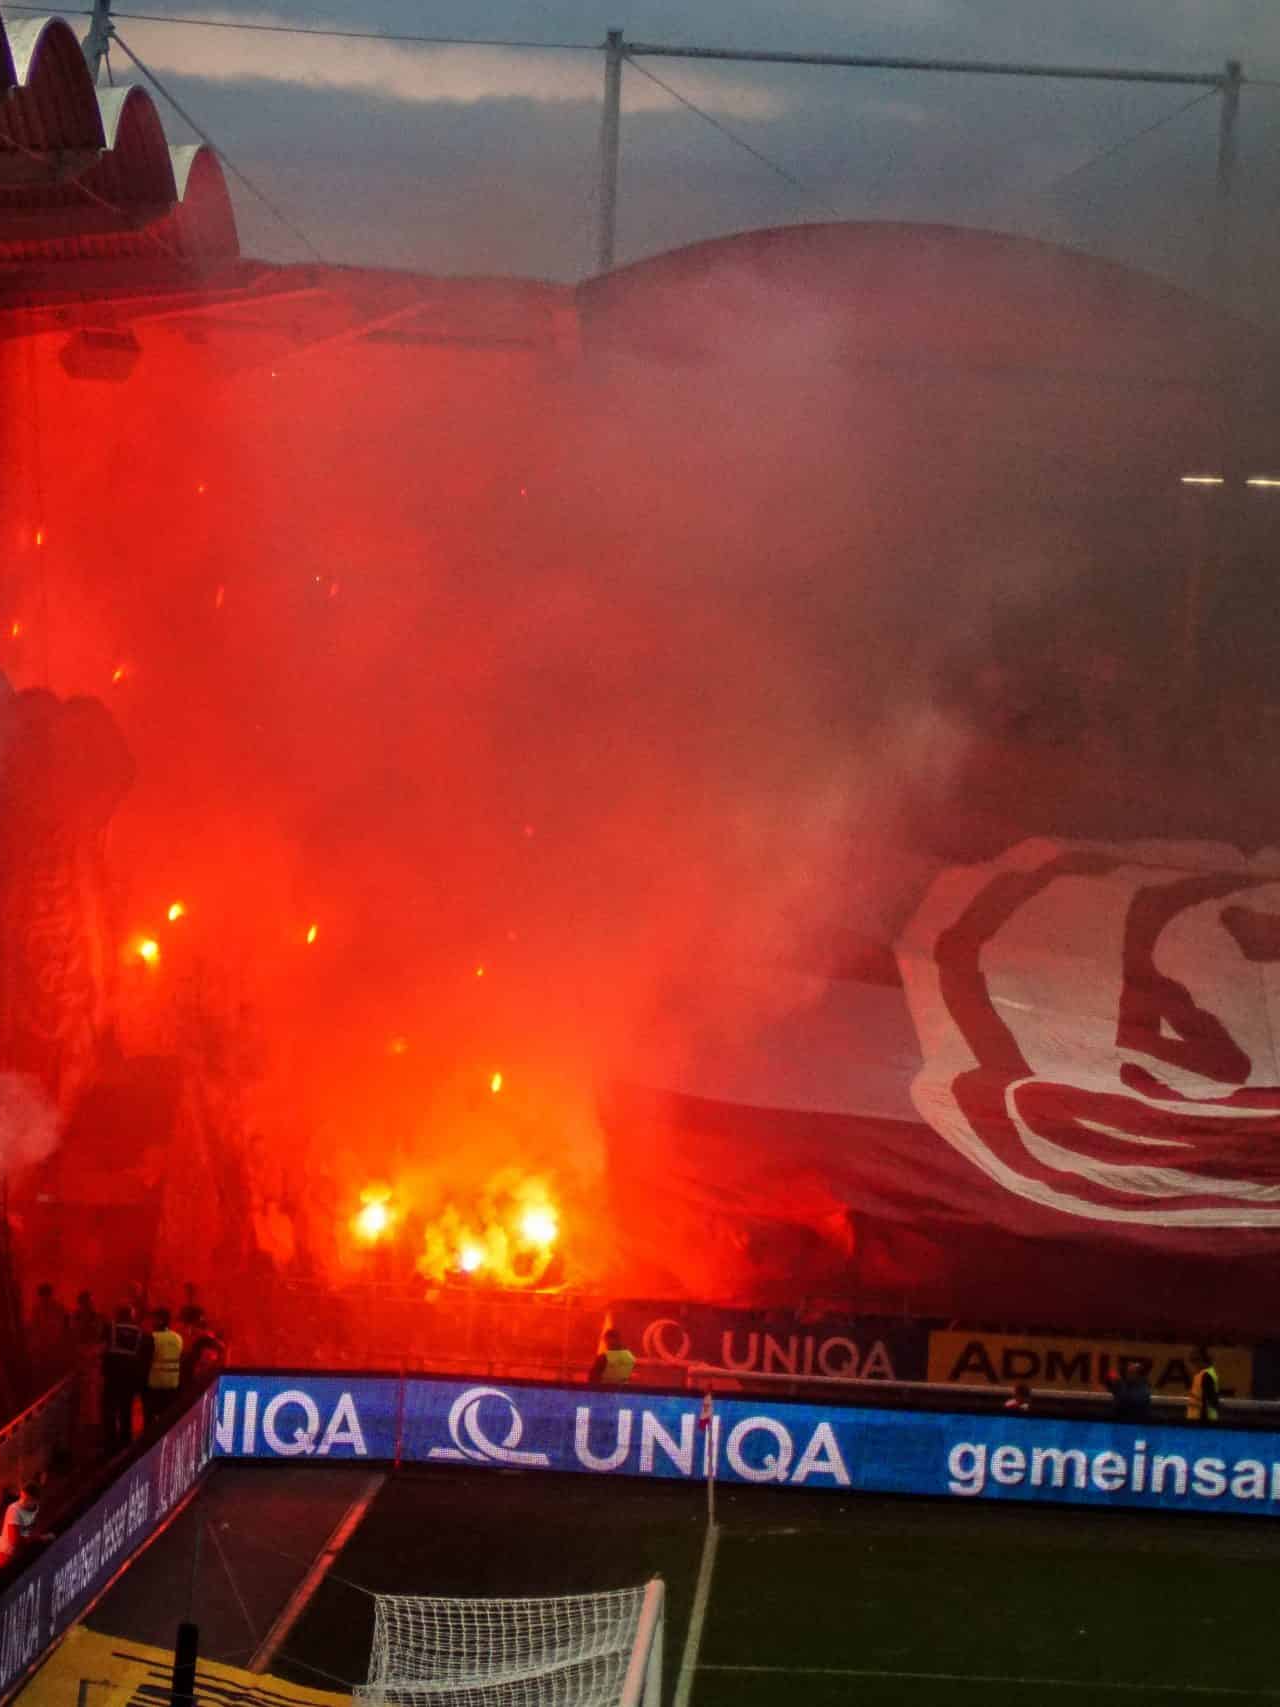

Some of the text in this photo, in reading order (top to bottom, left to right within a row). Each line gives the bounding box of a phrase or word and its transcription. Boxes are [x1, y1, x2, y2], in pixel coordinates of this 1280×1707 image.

[722, 1330, 898, 1381] UNIQA
[948, 1340, 1236, 1396] ADMIRA
[573, 1406, 852, 1486] UNIQA
[946, 1439, 1280, 1500] gemeinsa
